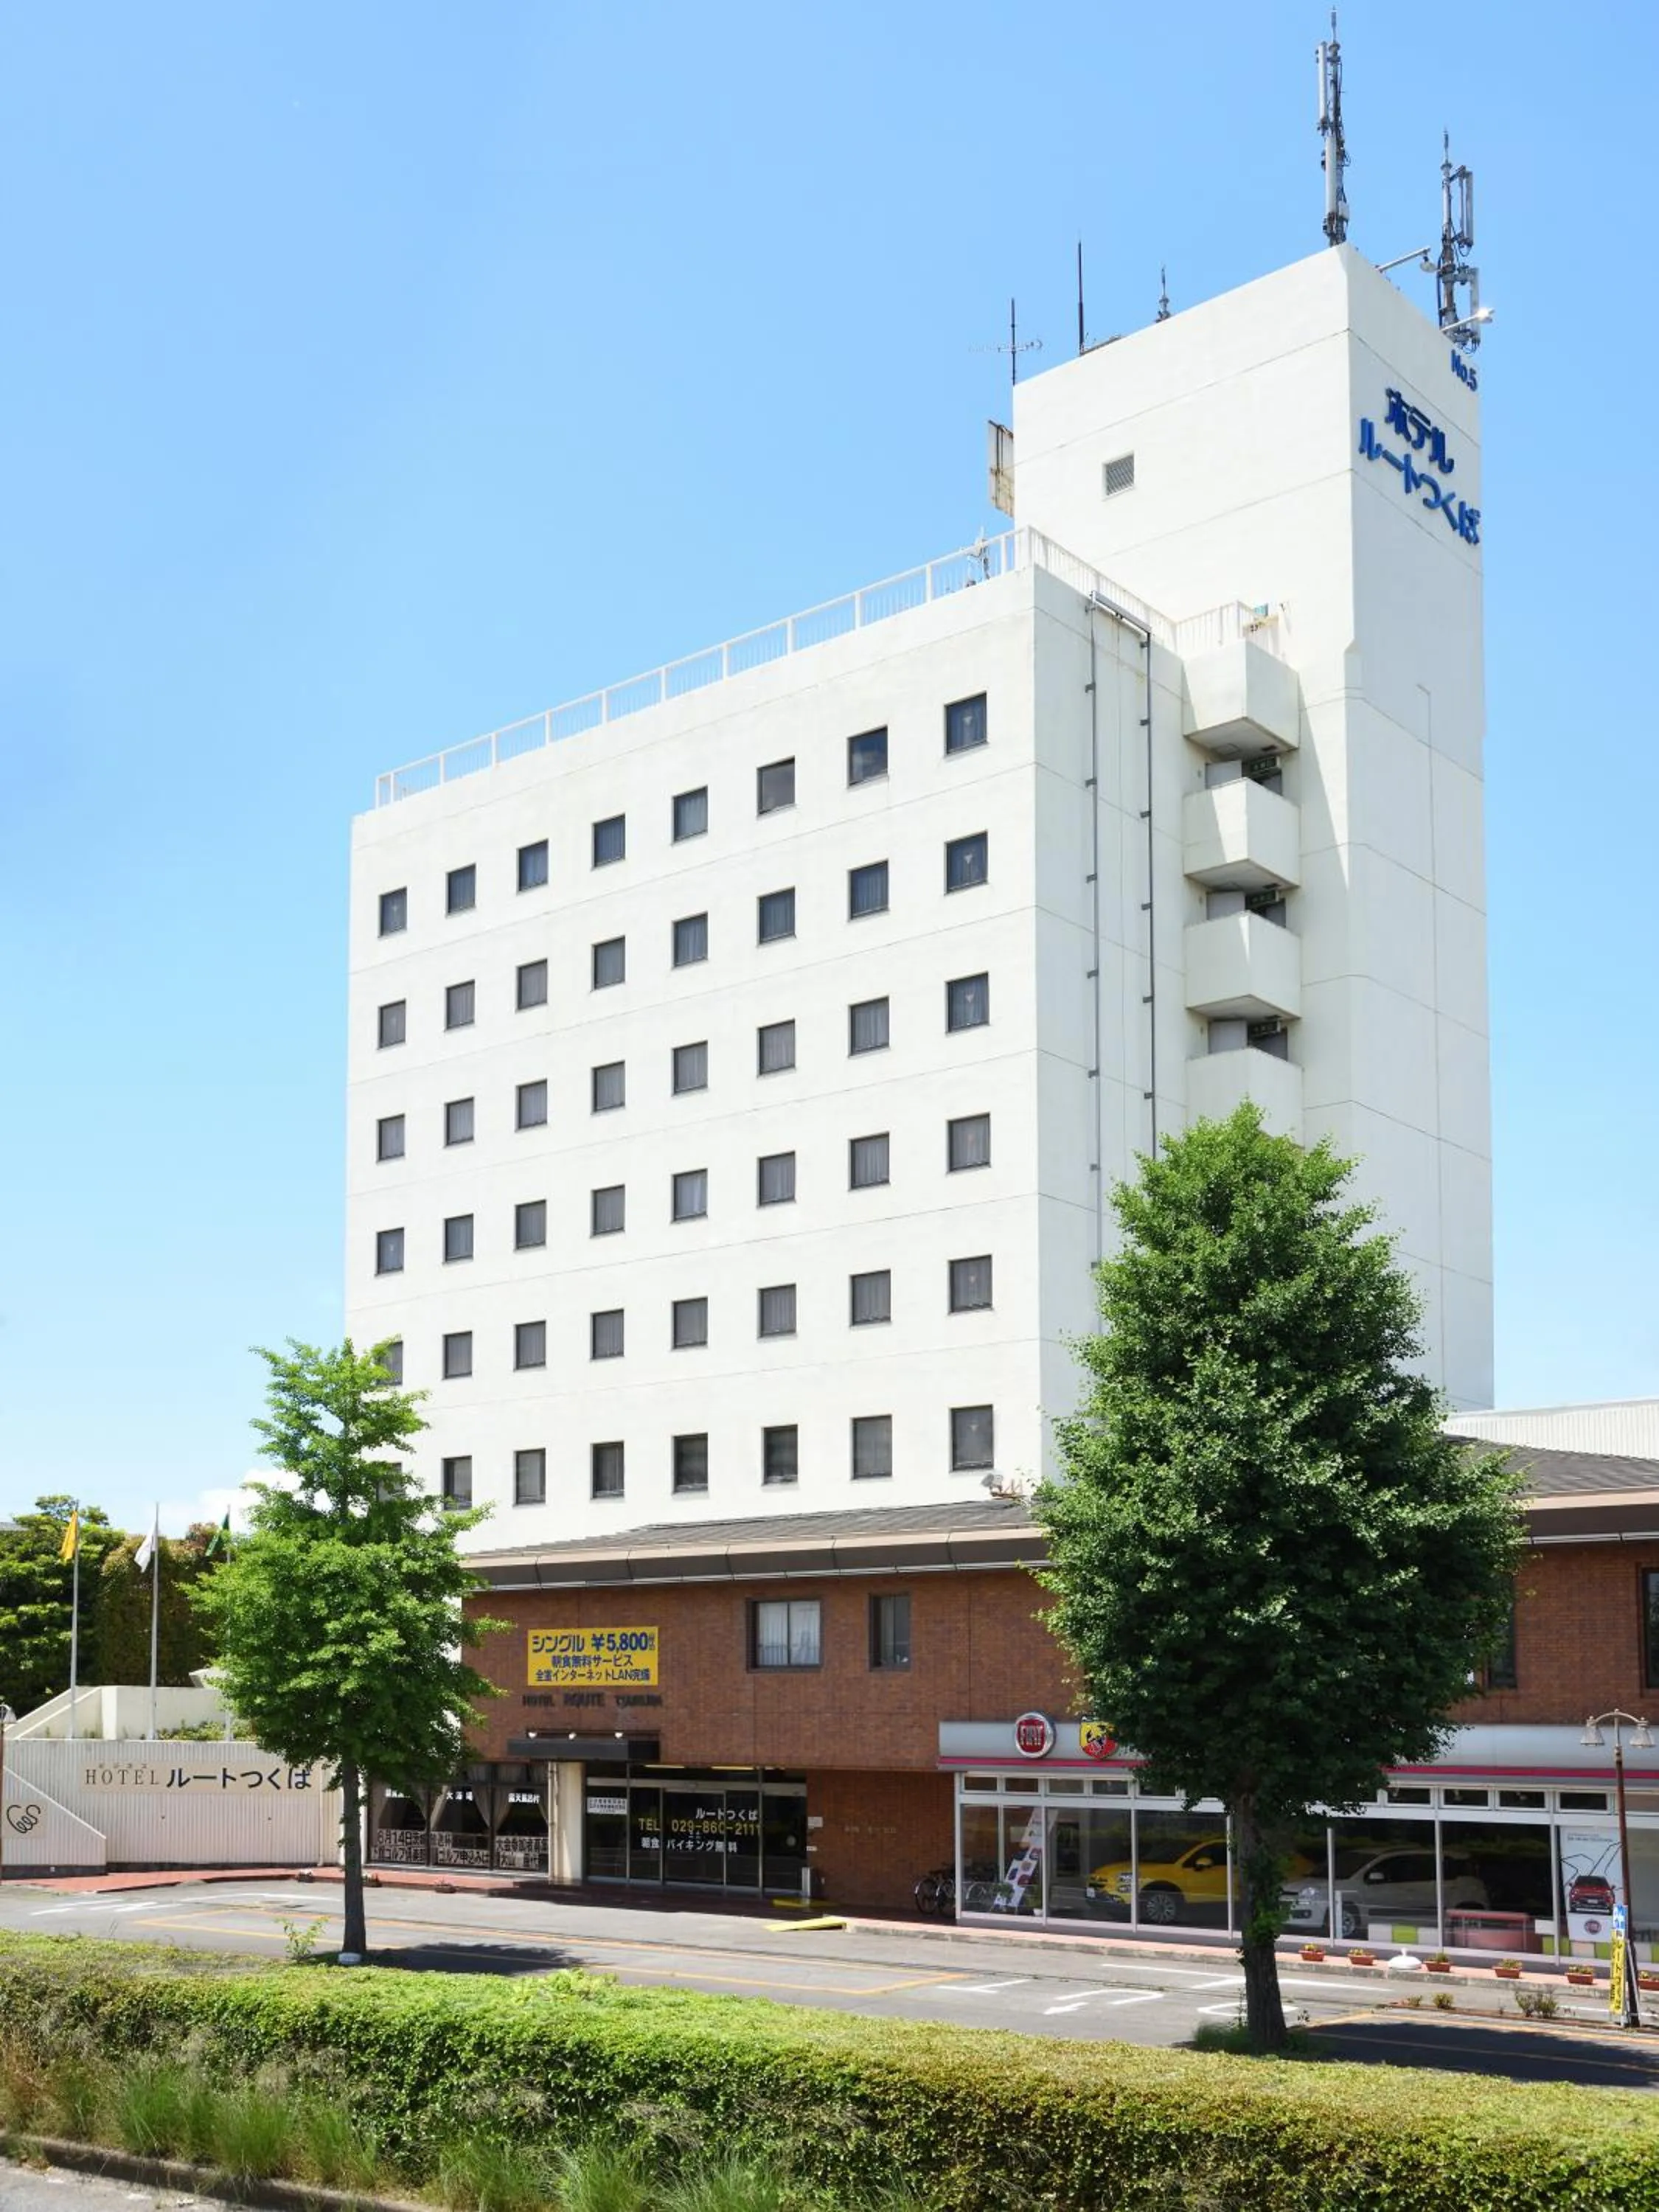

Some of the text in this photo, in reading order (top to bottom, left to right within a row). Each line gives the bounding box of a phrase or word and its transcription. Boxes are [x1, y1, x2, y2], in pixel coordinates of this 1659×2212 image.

[1385, 387, 1455, 473] ホテル
[1358, 417, 1481, 545] ルートつくば
[532, 1633, 585, 1652] シングル
[551, 1654, 633, 1668] 朝食無料サービス
[86, 1767, 313, 1790] HOTEL ルートつくば
[695, 1807, 758, 1820] ルートつくば
[639, 1818, 660, 1832] TEL
